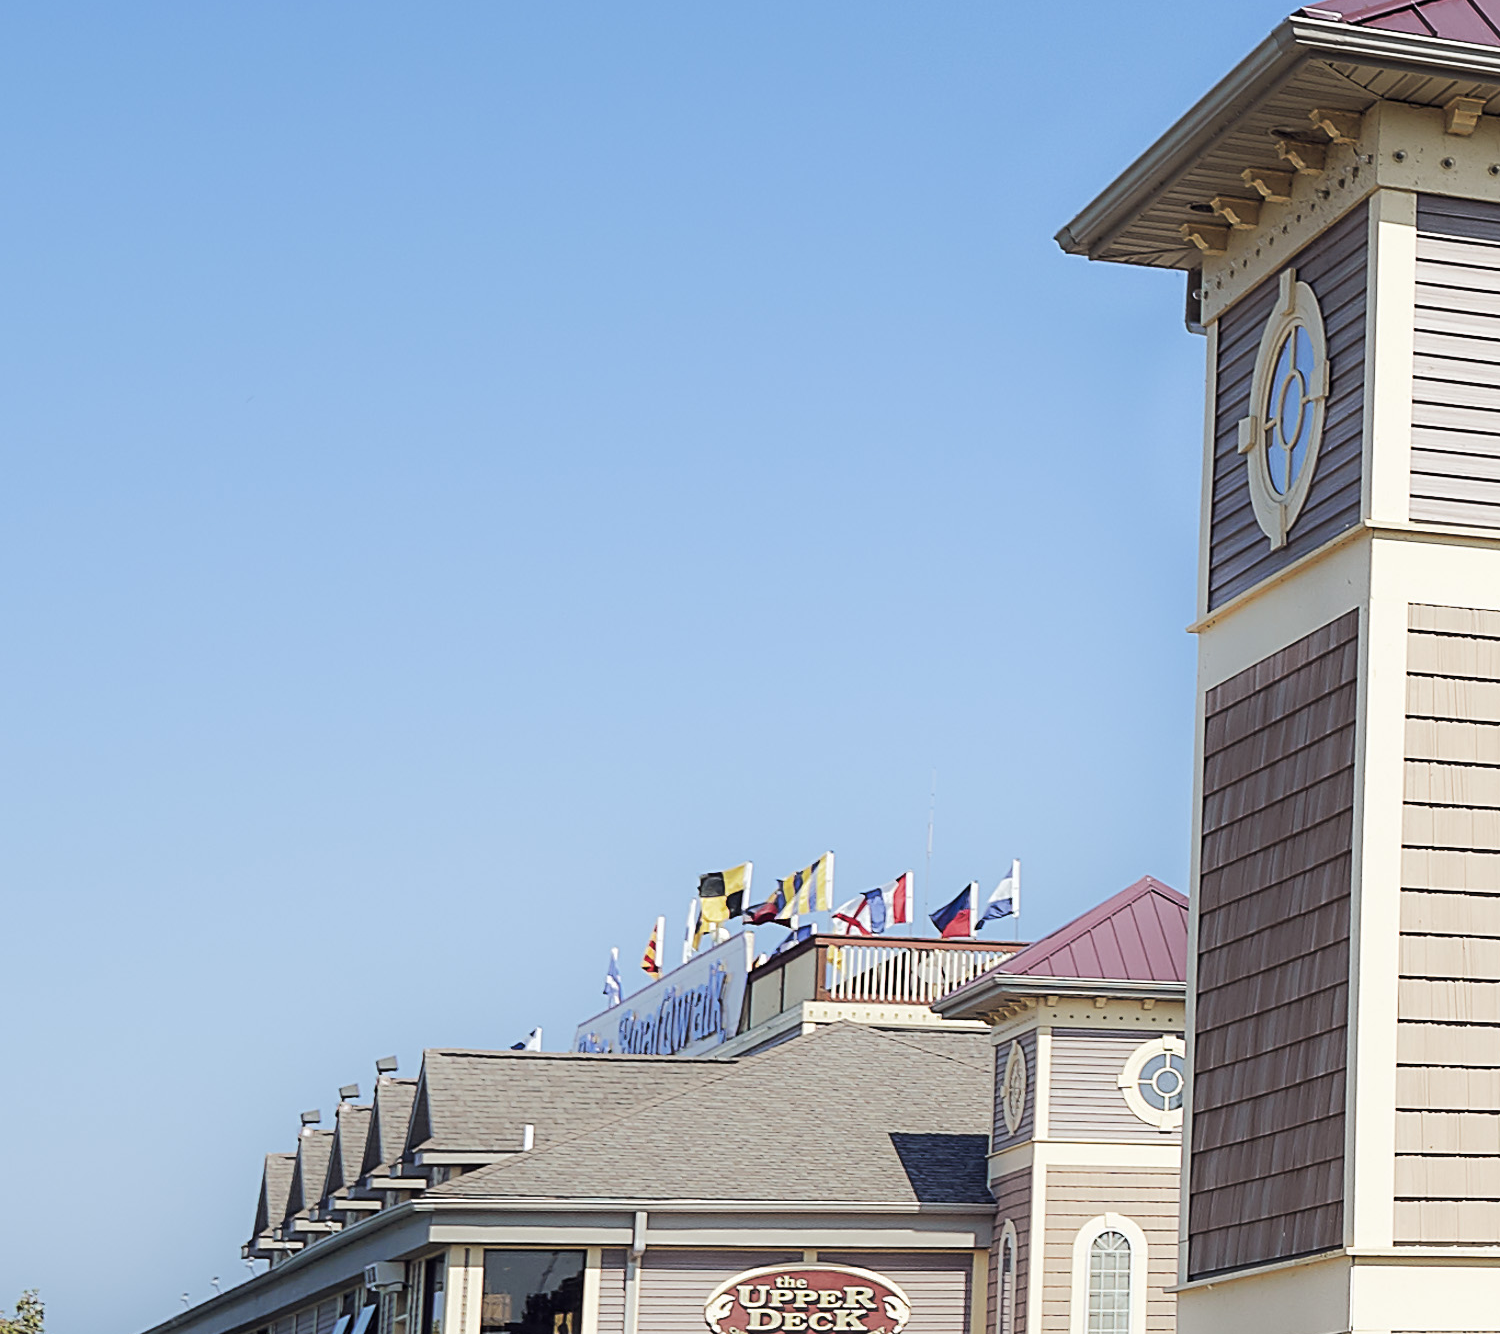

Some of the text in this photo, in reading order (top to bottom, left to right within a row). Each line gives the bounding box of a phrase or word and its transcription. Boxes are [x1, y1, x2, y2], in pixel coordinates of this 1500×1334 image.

[775, 1275, 808, 1289] the
[736, 1284, 878, 1310] UPPER
[745, 1308, 868, 1332] DECK
